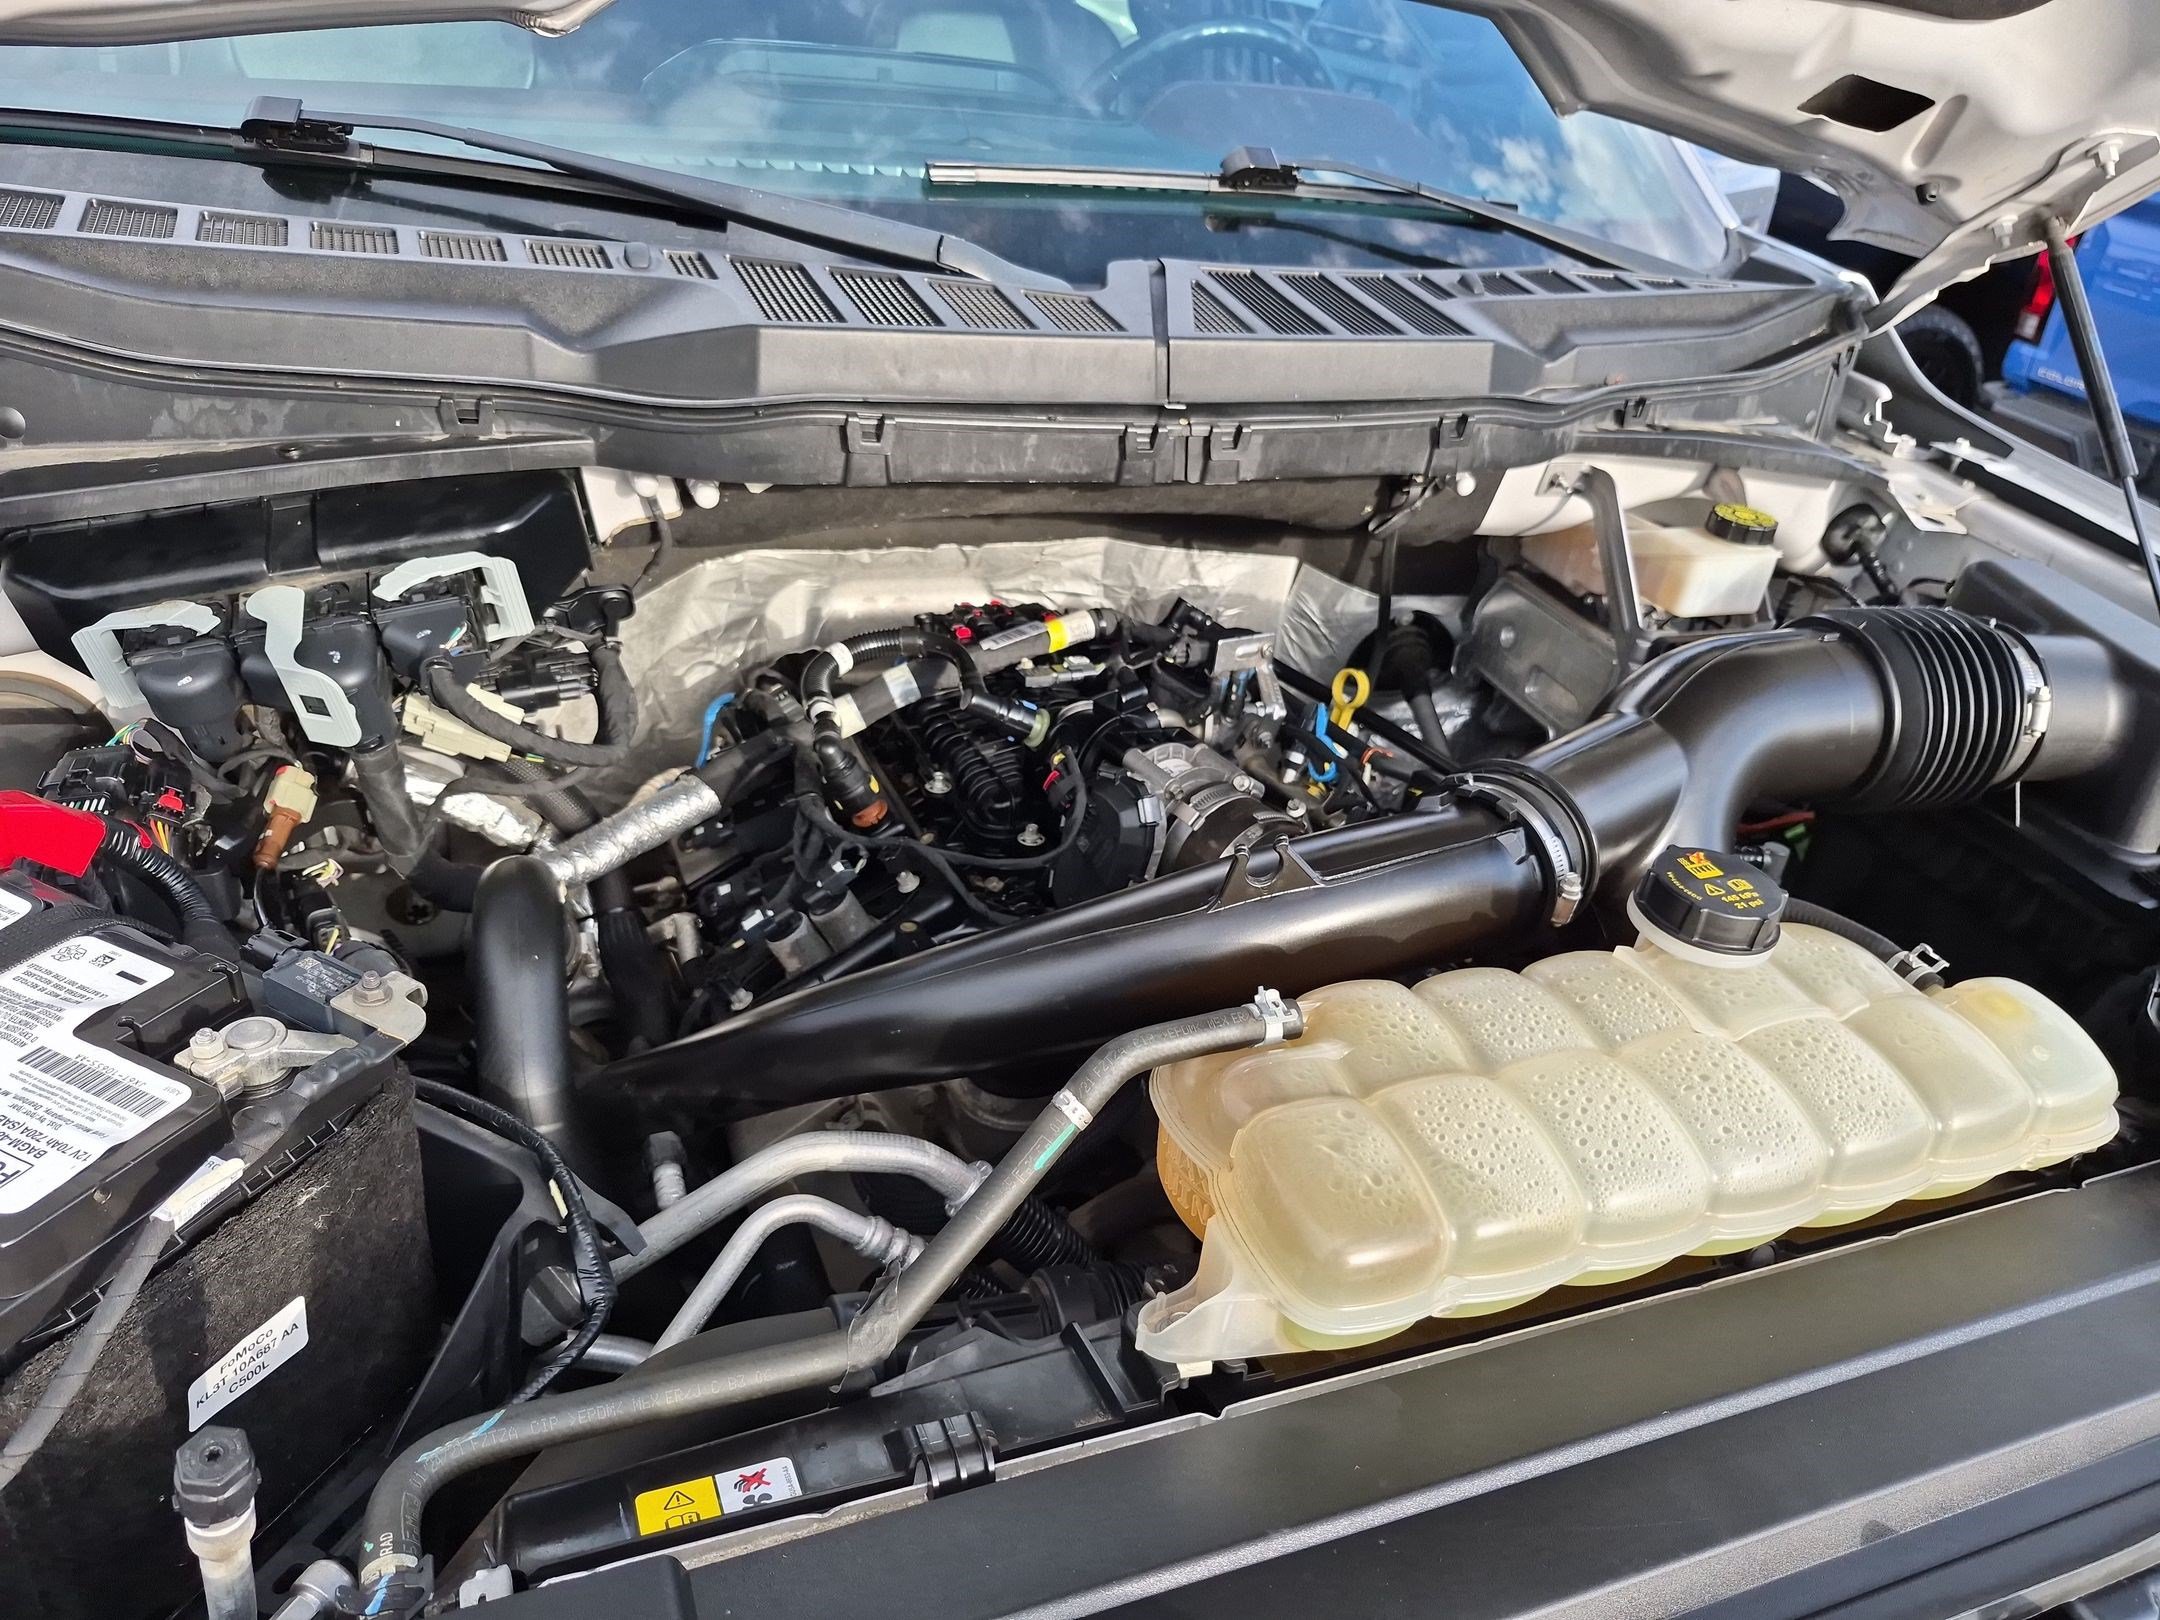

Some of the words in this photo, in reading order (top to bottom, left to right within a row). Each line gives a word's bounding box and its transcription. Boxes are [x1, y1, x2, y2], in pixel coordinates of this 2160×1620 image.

[17, 1126, 48, 1143] 720A
[42, 1137, 74, 1154] 70Ah
[67, 1148, 93, 1162] 12V
[220, 1329, 273, 1375] FoMoCo
[196, 1375, 228, 1409] KL3T
[233, 1338, 278, 1377] 10A687
[281, 1322, 299, 1341] AA
[228, 1361, 270, 1394] C500L
[379, 1531, 394, 1557] RAD
